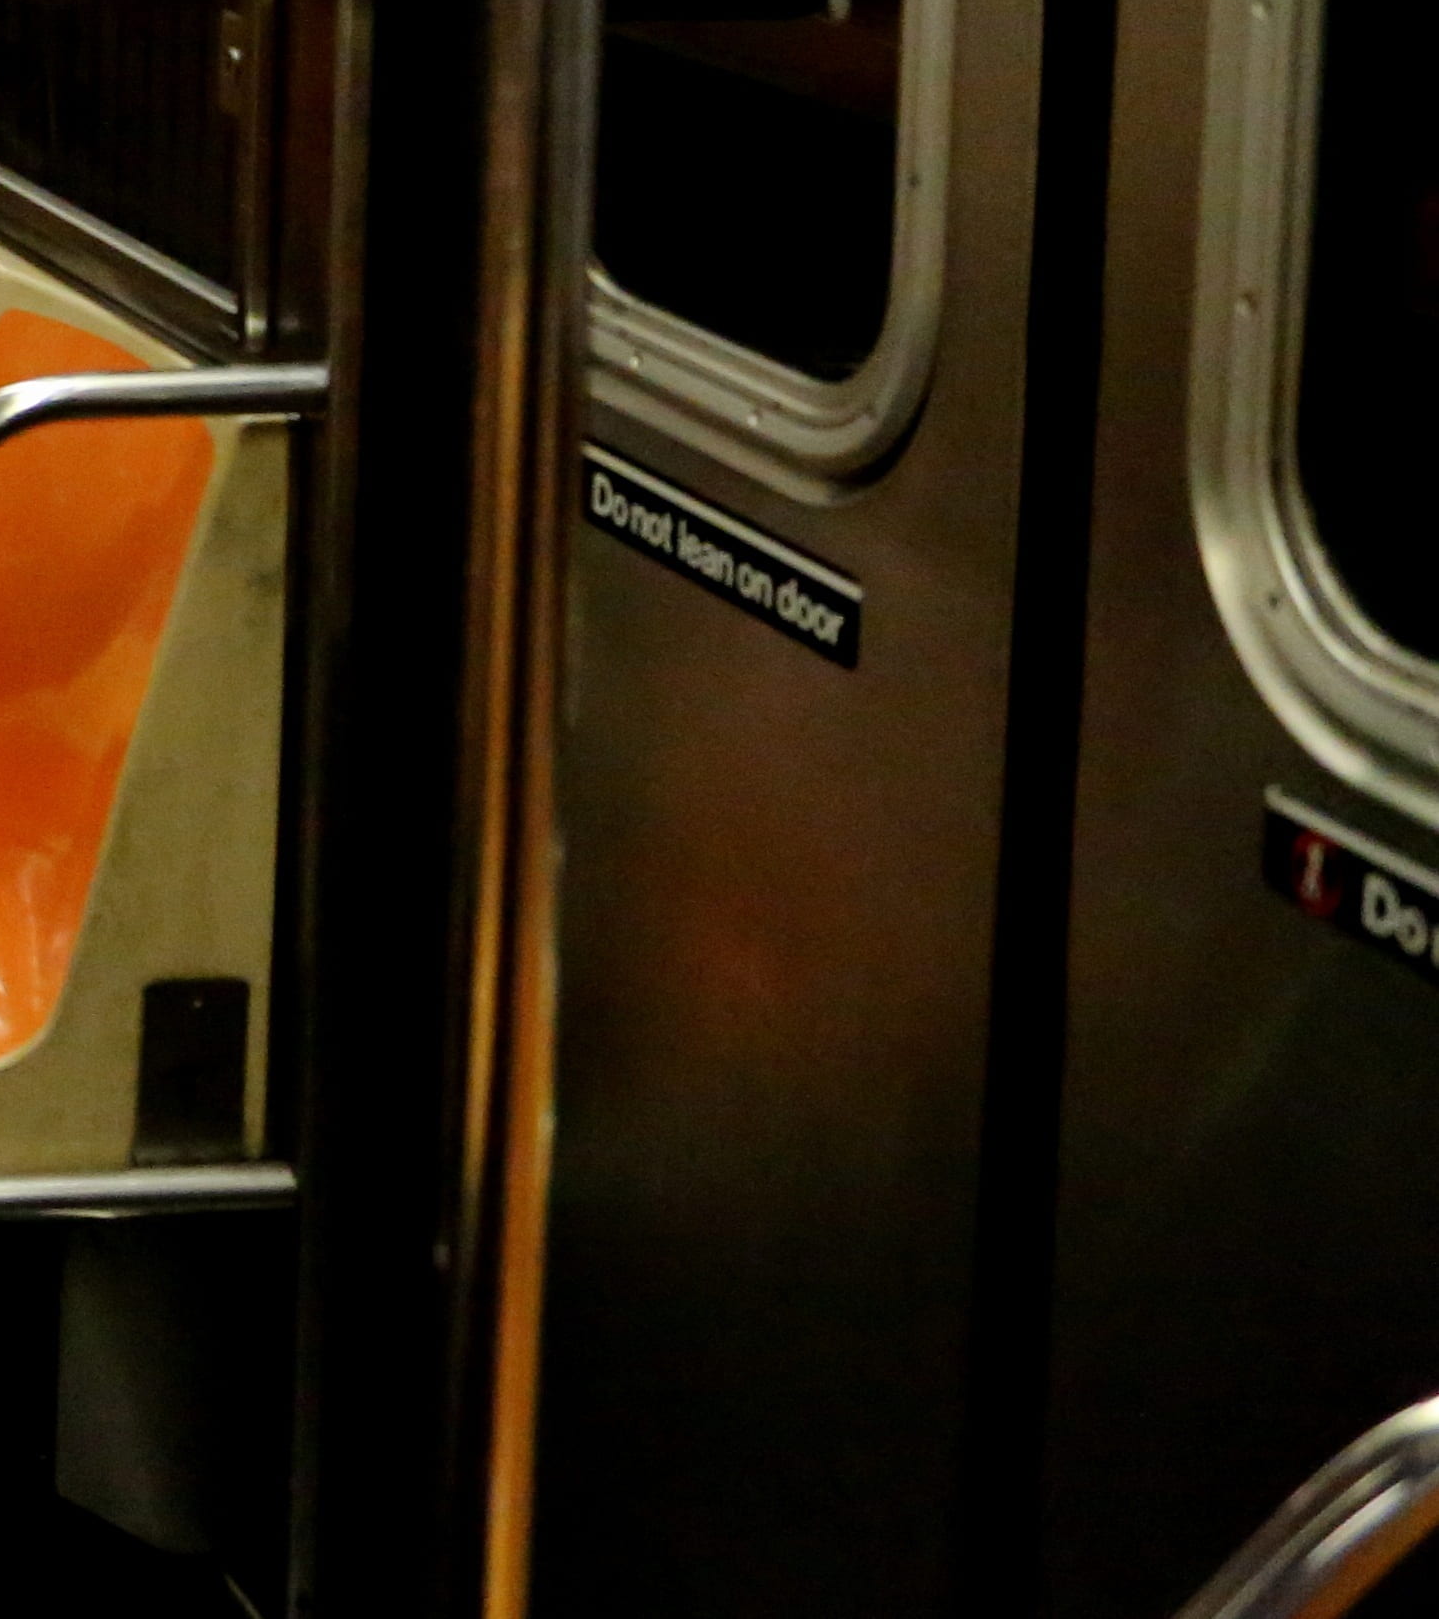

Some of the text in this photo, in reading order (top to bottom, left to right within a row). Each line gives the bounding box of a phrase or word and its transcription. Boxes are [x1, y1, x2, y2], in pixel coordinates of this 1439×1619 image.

[590, 471, 846, 646] Do not lean on door
[1360, 871, 1429, 957] Do
